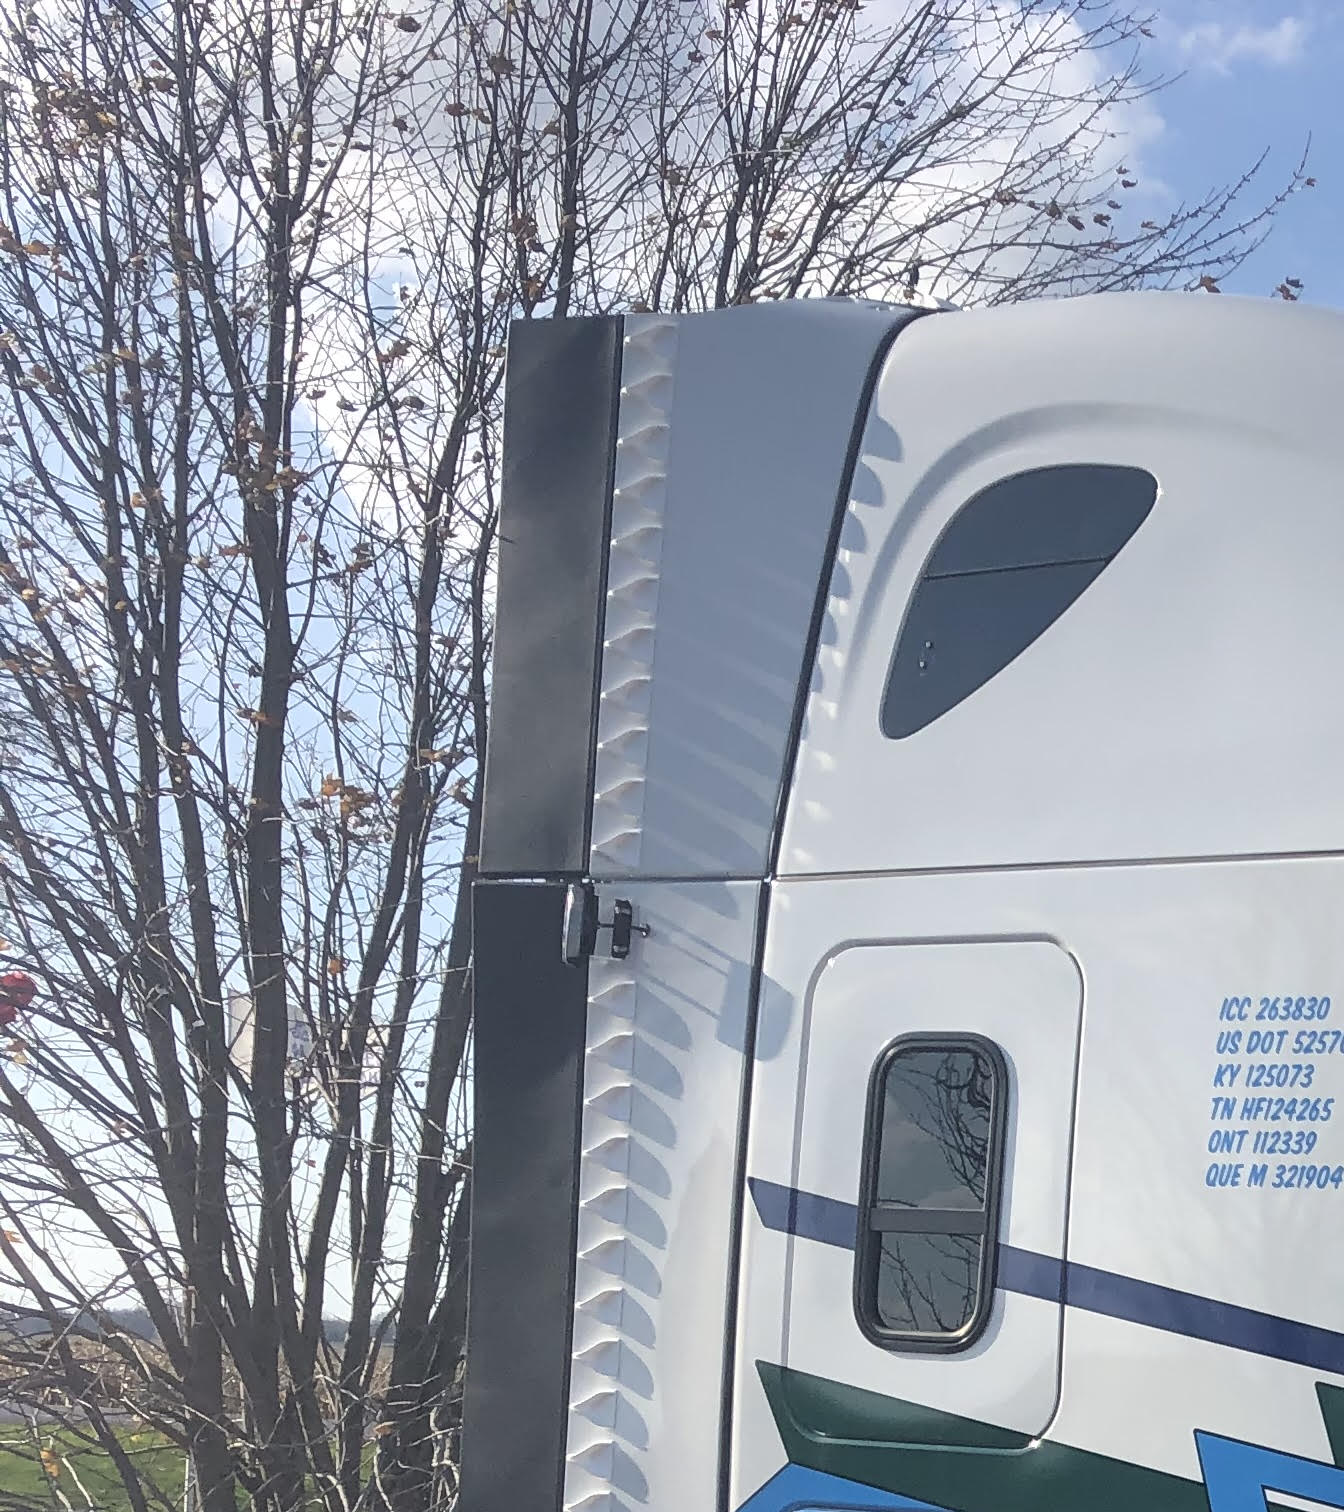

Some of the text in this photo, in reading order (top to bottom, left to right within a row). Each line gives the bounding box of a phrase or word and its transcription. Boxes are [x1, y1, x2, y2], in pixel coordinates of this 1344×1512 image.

[1219, 996, 1331, 1021] ICC 263830
[1216, 1030, 1242, 1054] US
[1246, 1030, 1289, 1054] DOT
[1213, 1063, 1315, 1088] KY 125073
[1210, 1097, 1335, 1122] TN HF124265
[1207, 1130, 1318, 1155] ONT 112339
[1205, 1163, 1344, 1189] QUE M 321904
